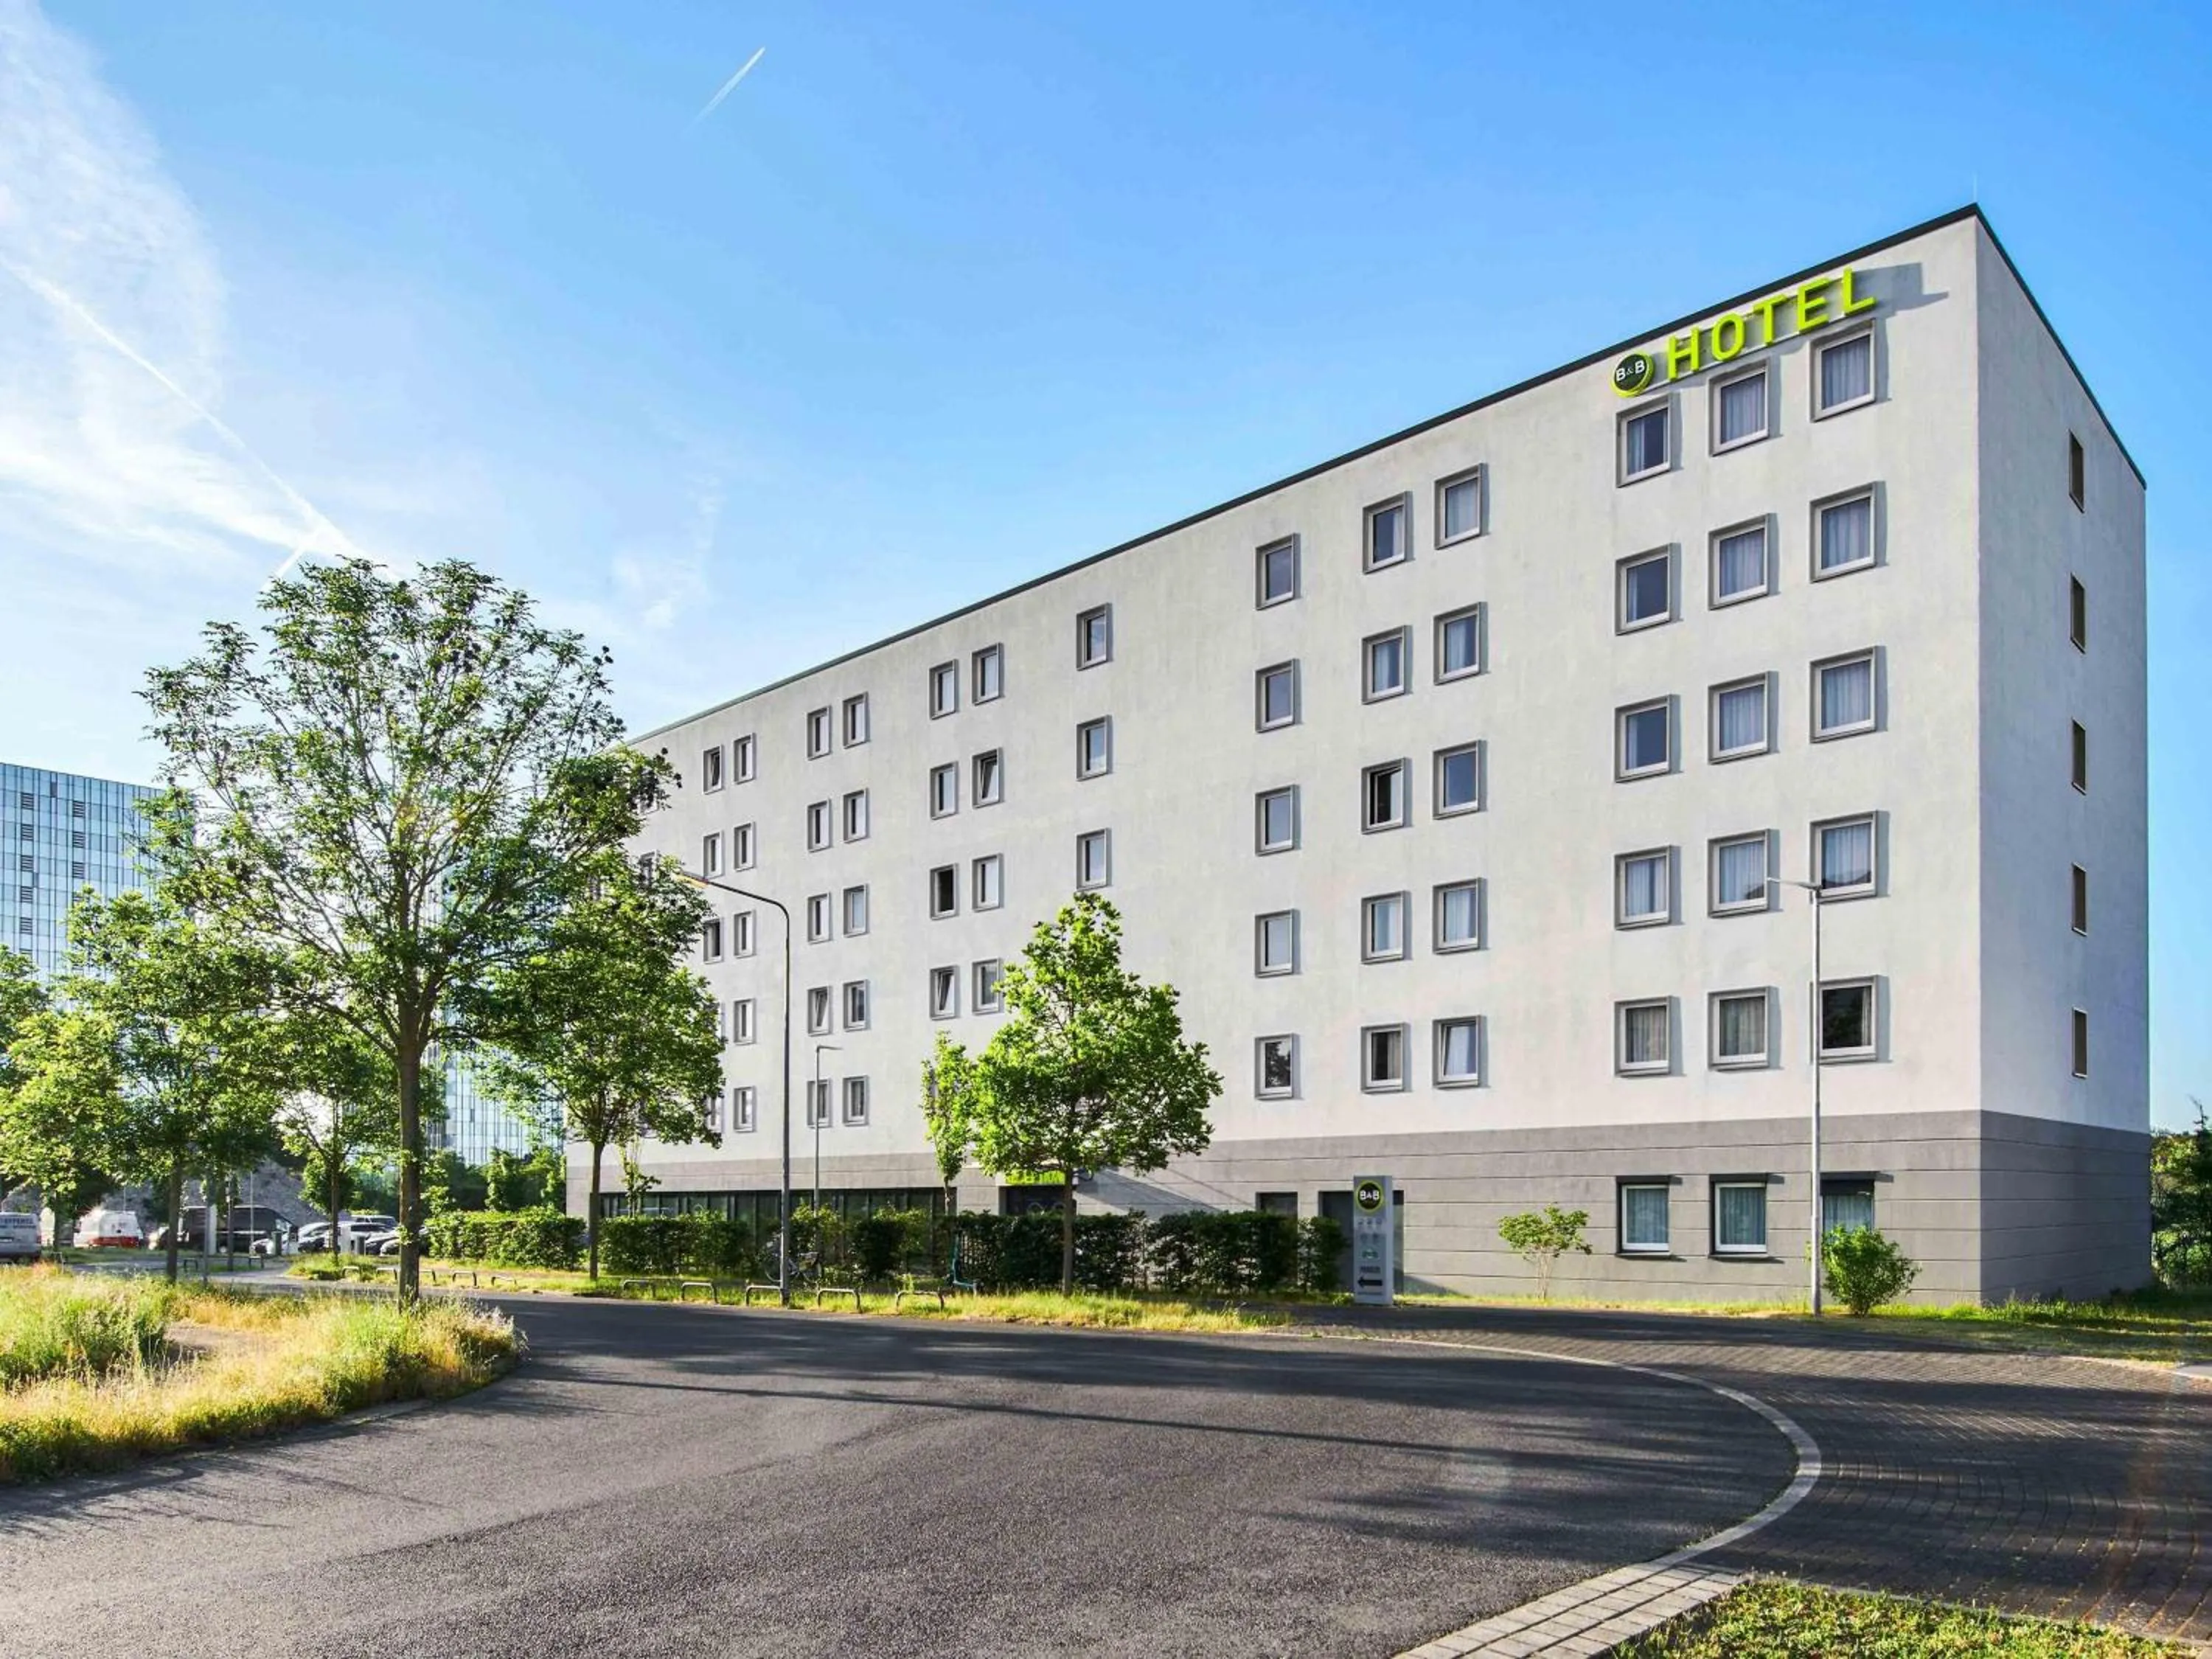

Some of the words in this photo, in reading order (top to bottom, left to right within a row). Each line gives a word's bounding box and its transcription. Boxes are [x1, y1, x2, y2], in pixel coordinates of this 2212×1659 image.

[1615, 359, 1645, 382] B&B
[1667, 267, 1877, 381] HOTEL
[1359, 1189, 1380, 1200] B&B
